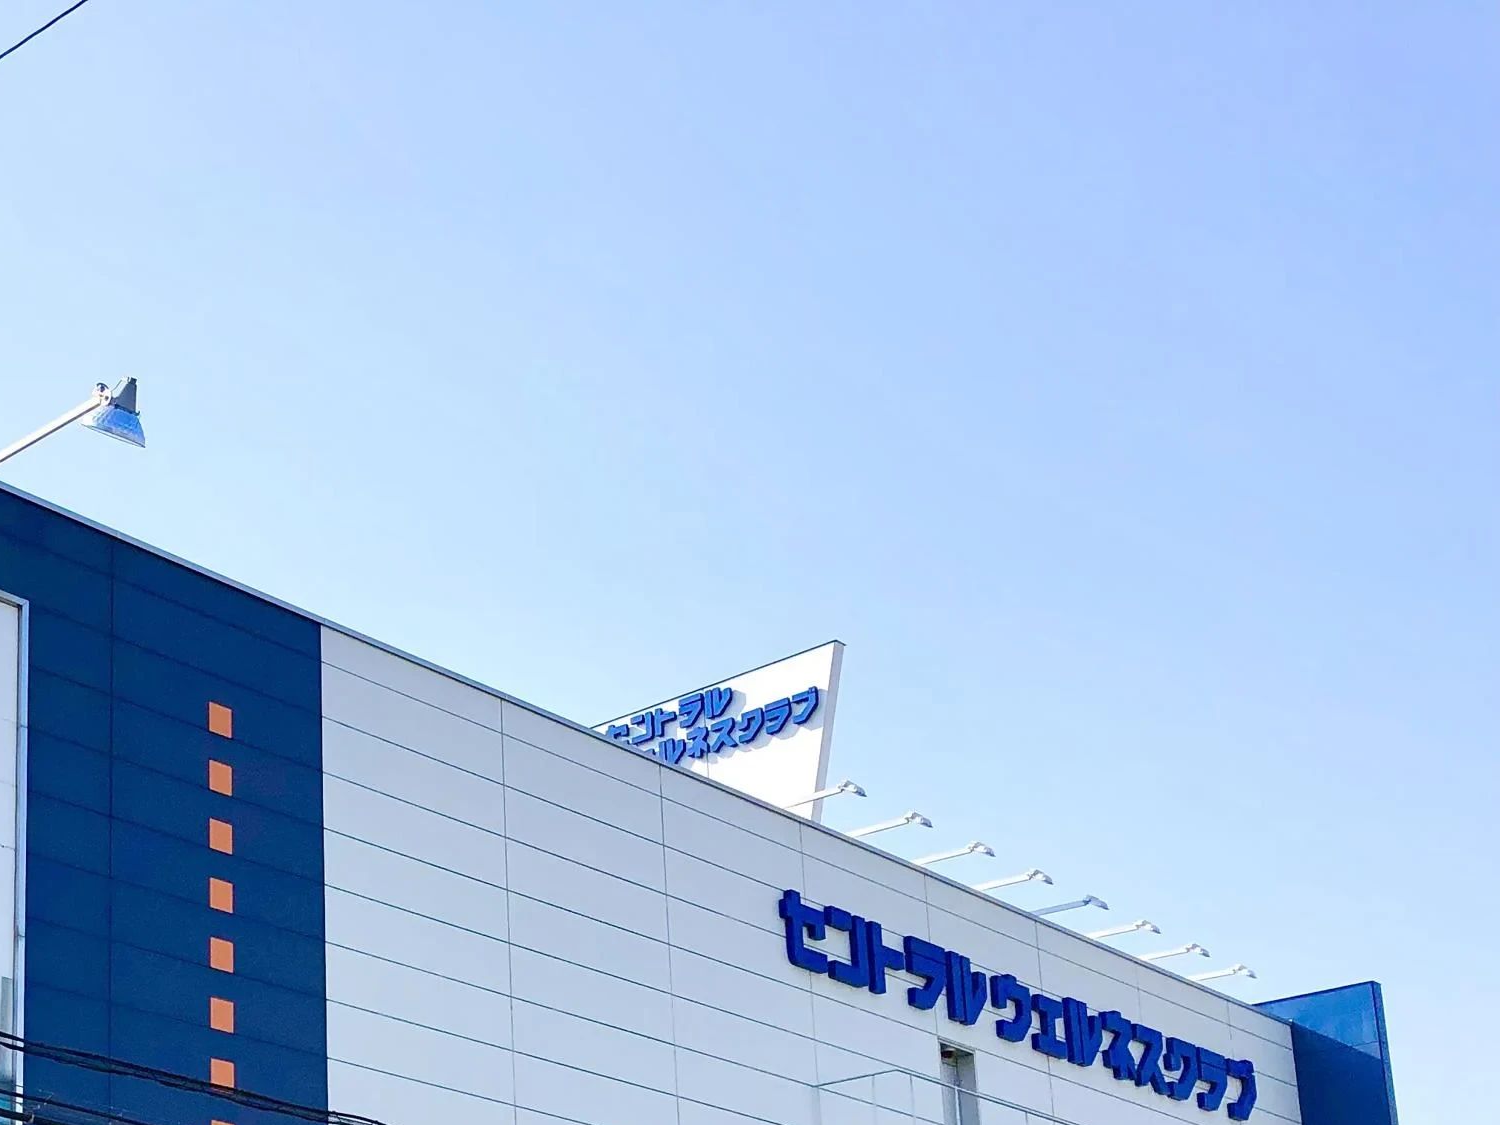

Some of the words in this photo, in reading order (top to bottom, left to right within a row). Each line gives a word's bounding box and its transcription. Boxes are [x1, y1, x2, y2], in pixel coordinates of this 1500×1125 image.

[651, 686, 819, 764] ルネスクラブ
